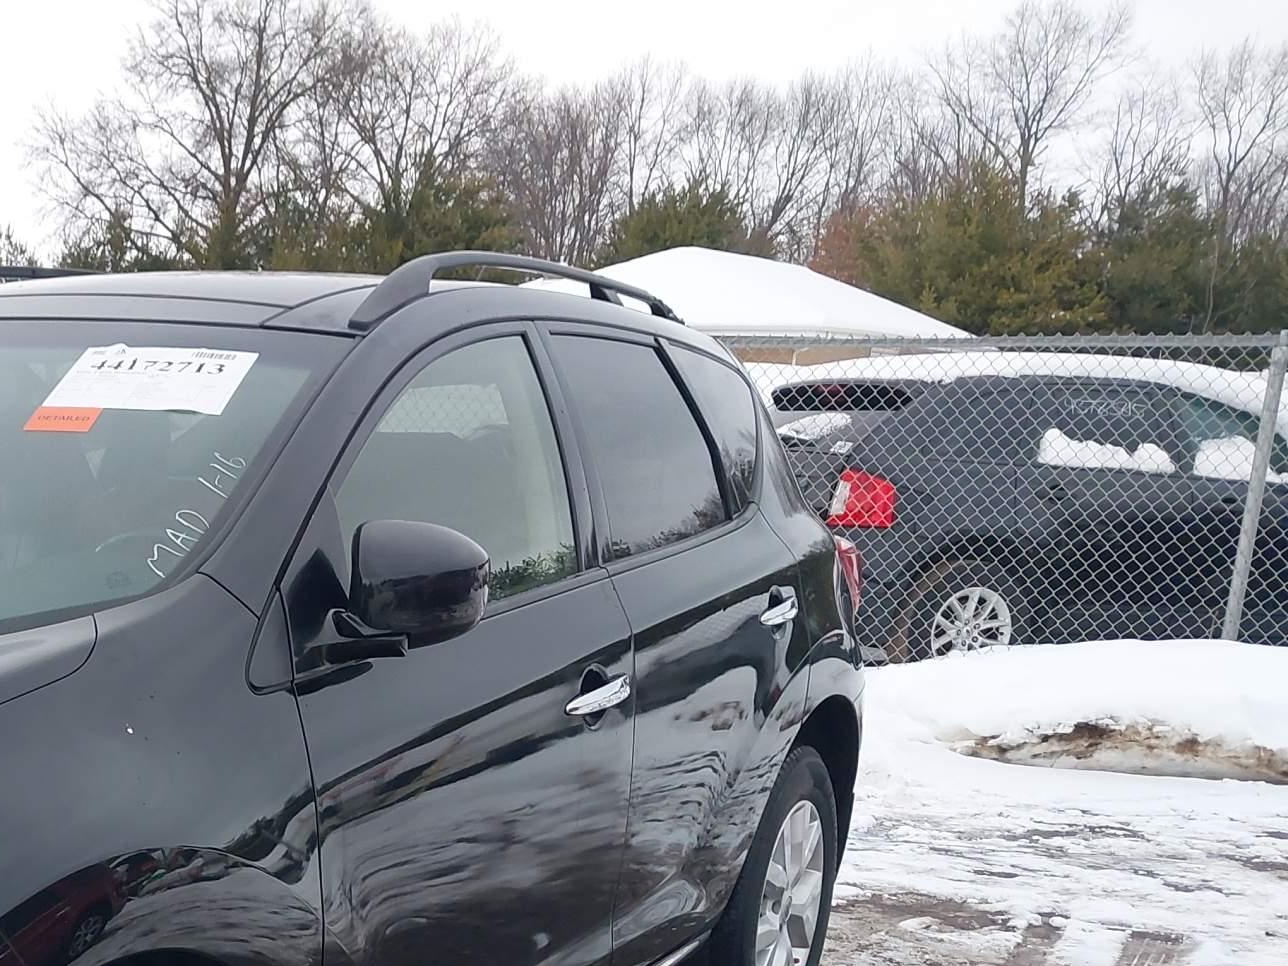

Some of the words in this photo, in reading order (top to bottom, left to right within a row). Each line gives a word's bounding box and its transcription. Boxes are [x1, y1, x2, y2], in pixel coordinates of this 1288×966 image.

[90, 357, 226, 376] 44172713
[37, 414, 91, 422] DETAILED
[146, 509, 210, 578] MAD
[197, 451, 247, 499] 1-16
